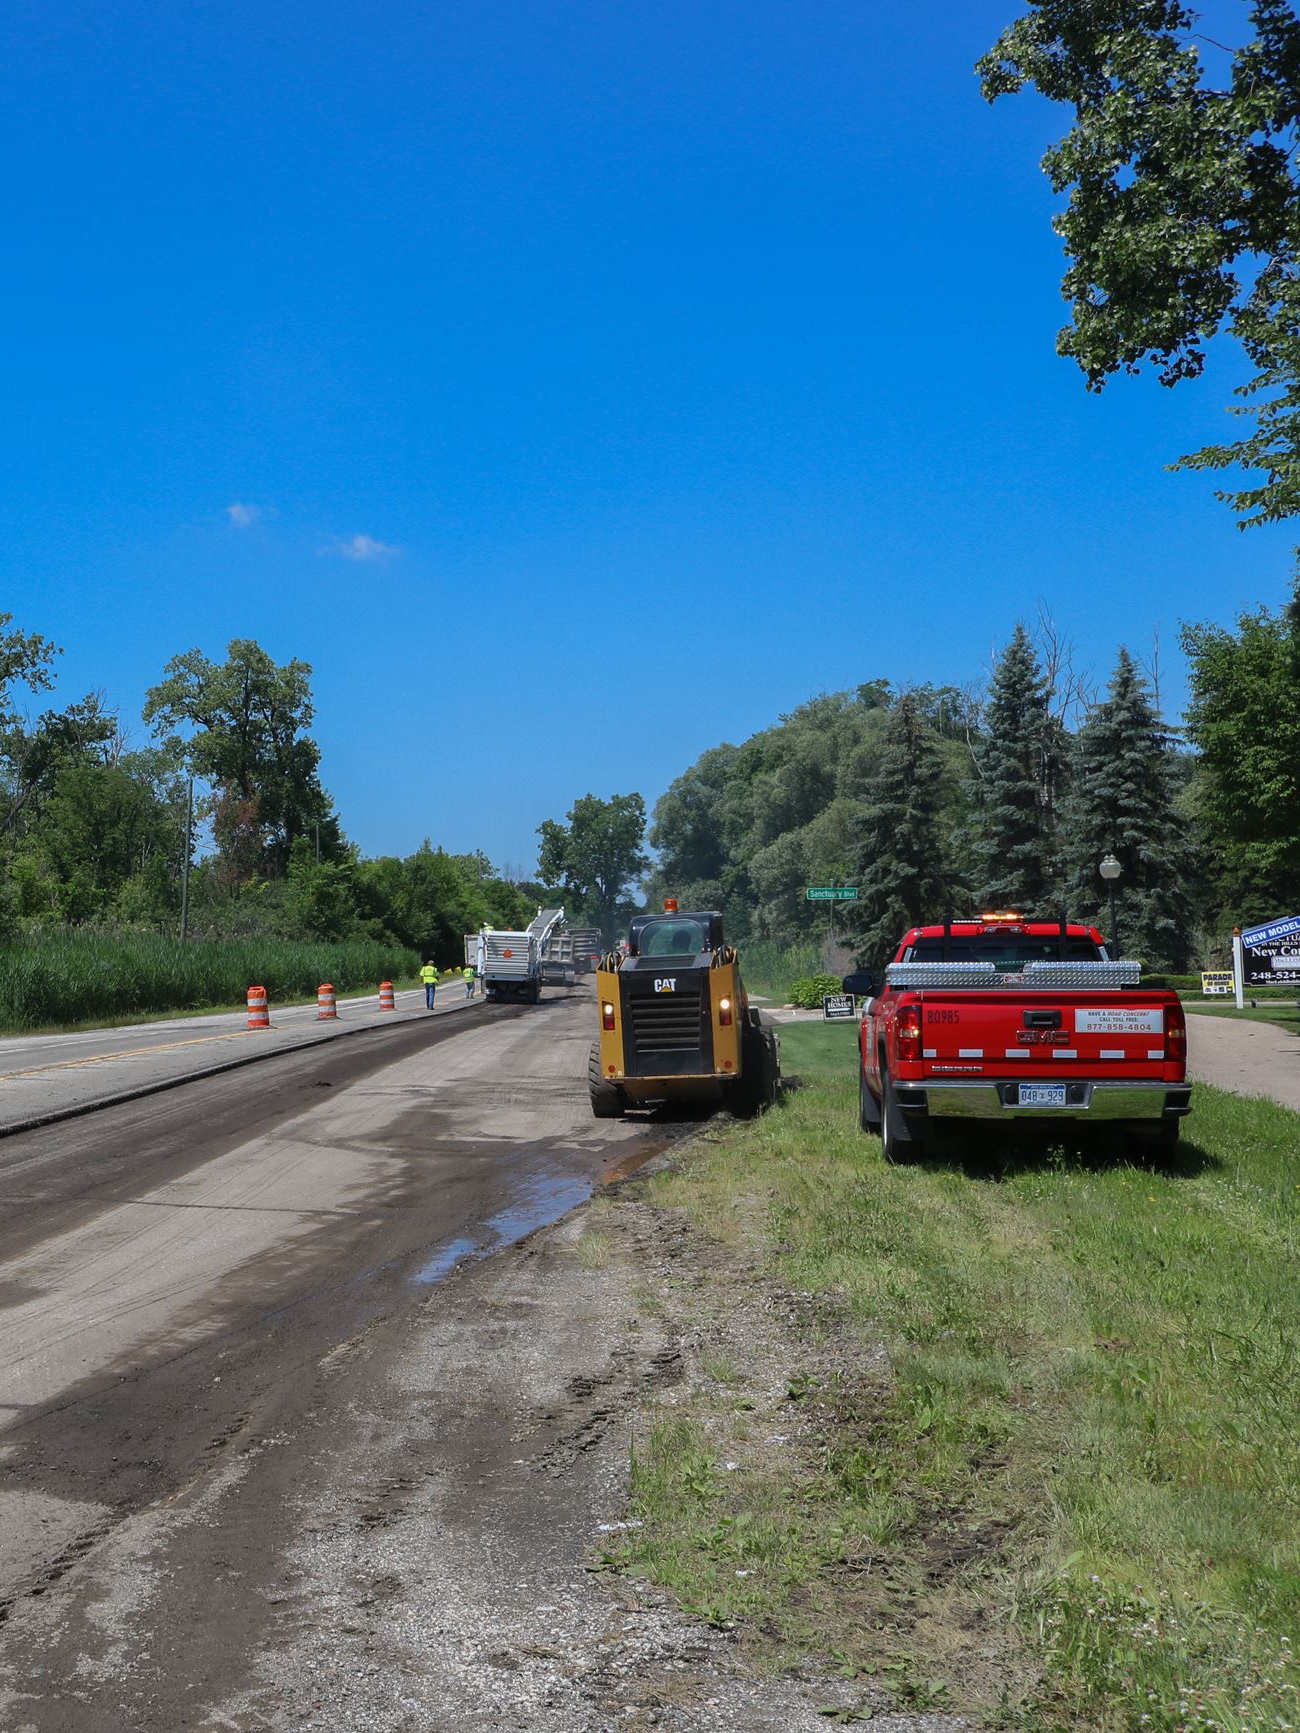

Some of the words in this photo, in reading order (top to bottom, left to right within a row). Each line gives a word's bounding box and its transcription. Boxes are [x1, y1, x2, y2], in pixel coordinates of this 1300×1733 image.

[810, 890, 842, 899] Sanctuary
[1245, 931, 1267, 945] NEW
[1268, 921, 1300, 937] MODEL
[1251, 947, 1277, 957] New
[1203, 973, 1233, 981] PARADE
[654, 978, 676, 992] CAT
[827, 1001, 852, 1009] HOMES
[927, 1010, 960, 1024] 80985
[1016, 1030, 1069, 1043] GMC
[1047, 1090, 1064, 1101] 929
